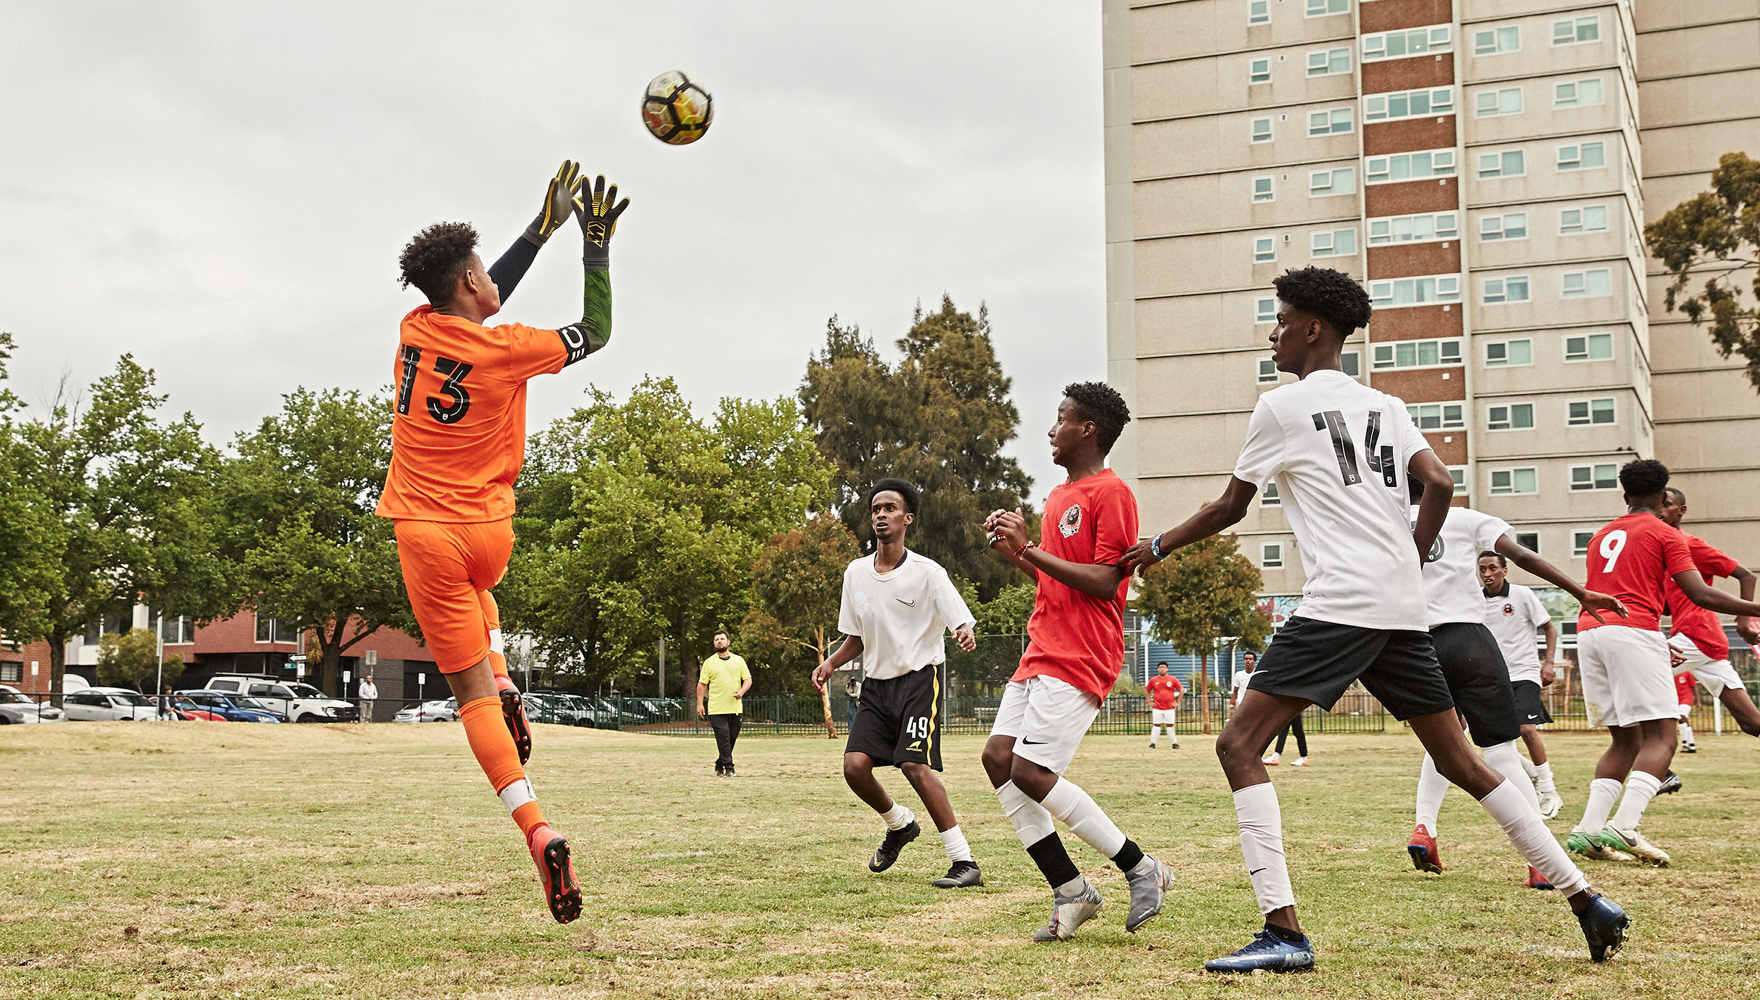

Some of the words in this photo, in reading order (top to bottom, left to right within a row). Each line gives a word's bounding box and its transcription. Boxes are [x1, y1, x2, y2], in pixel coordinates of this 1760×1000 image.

[397, 344, 473, 424] 13
[1312, 410, 1397, 487] 14
[1599, 530, 1627, 574] 9
[906, 716, 928, 738] 49
